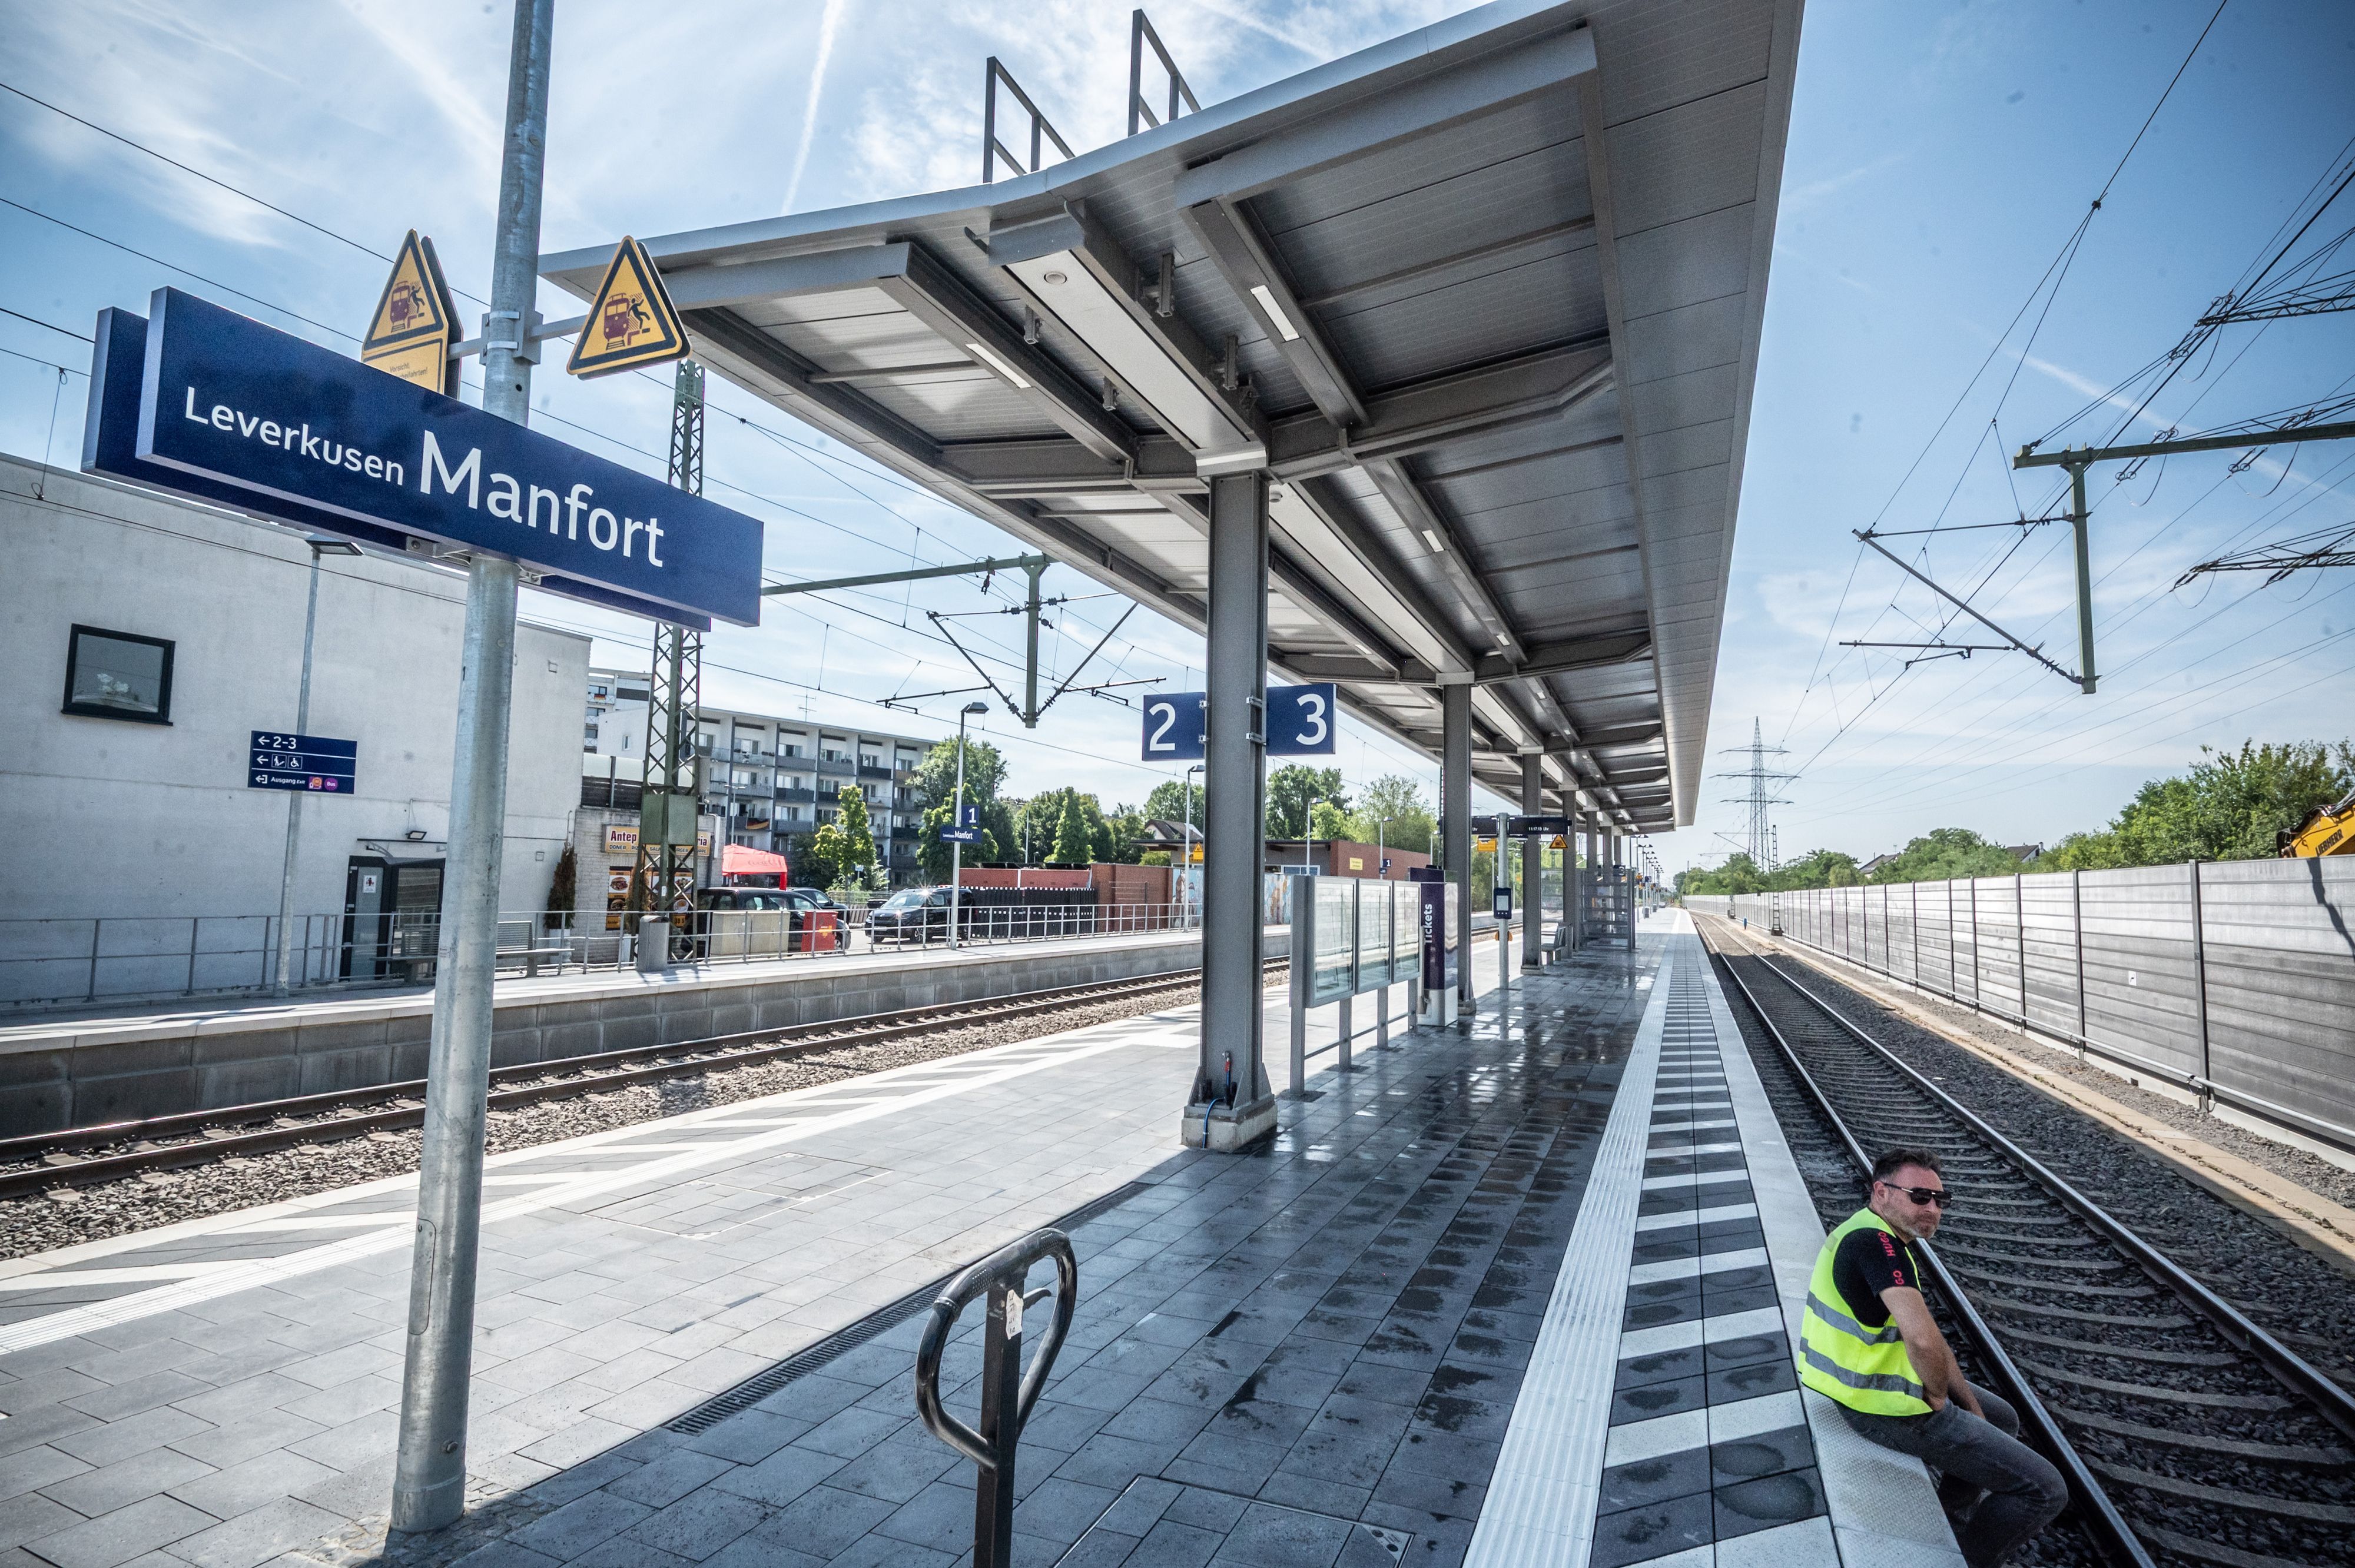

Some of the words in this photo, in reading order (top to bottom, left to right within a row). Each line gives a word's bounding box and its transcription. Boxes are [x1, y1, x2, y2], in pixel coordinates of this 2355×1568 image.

[185, 386, 403, 486] Leverkusen
[420, 430, 664, 567] Manfort
[1149, 702, 1176, 751] 2
[1296, 693, 1327, 745] 3
[273, 736, 297, 749] 2-3
[271, 776, 296, 785] Ausgang
[969, 808, 977, 823] 1
[610, 830, 637, 844] Antep
[954, 830, 973, 840] Manfort
[2315, 828, 2344, 857] LIEBHERR
[1878, 1231, 1896, 1257] HUGO
